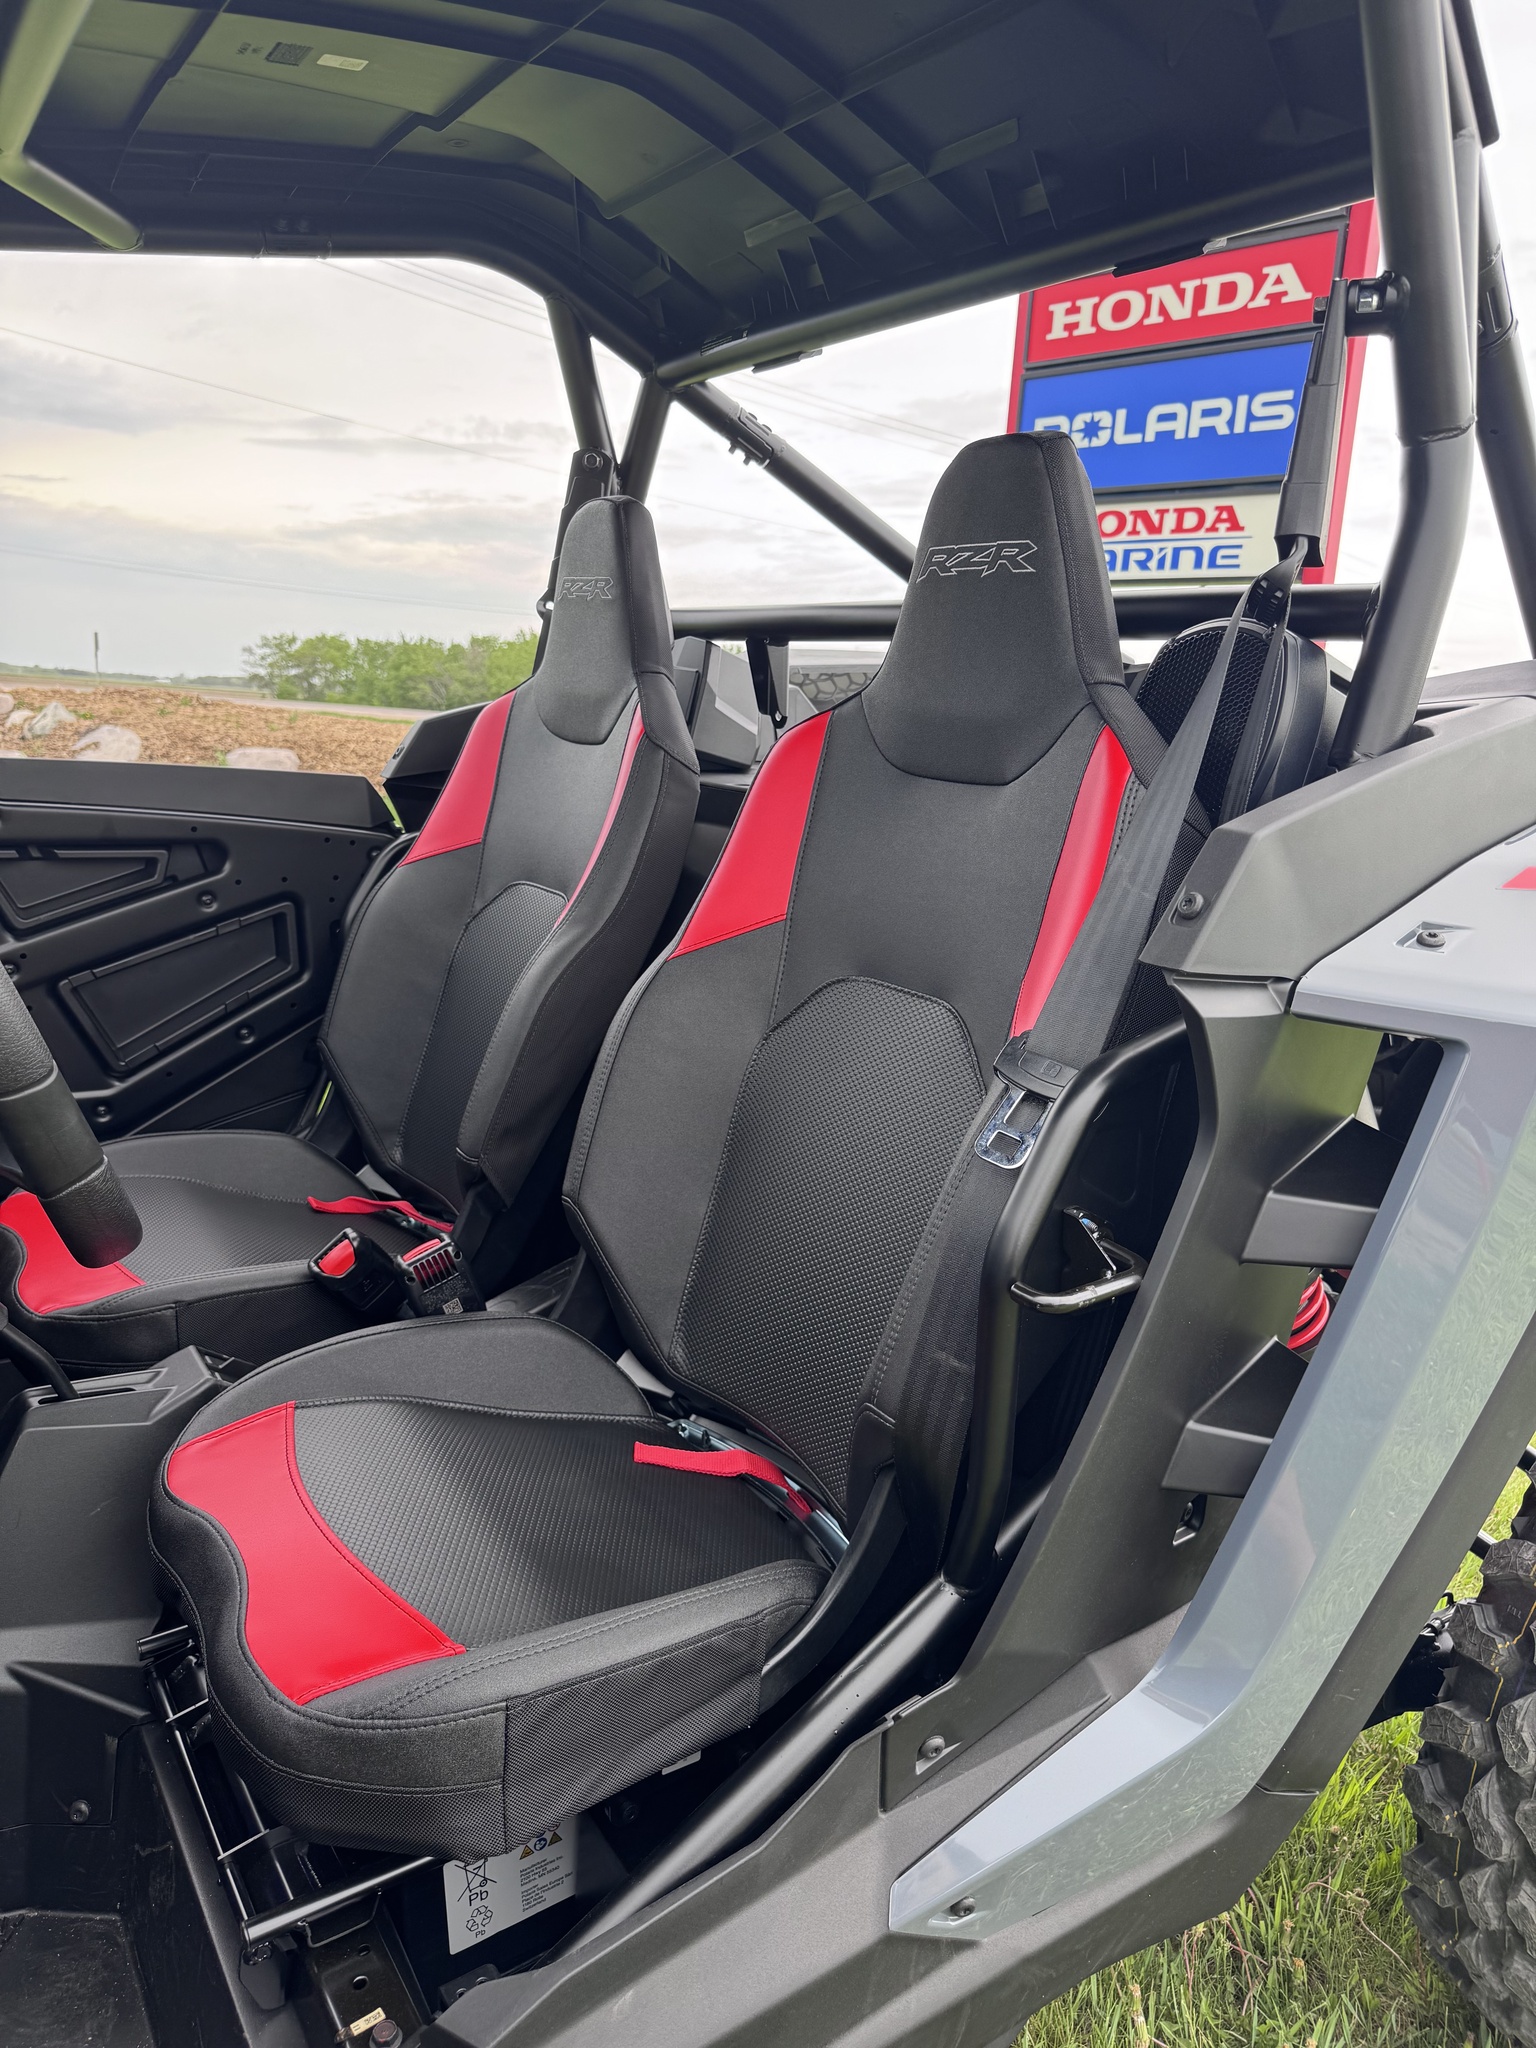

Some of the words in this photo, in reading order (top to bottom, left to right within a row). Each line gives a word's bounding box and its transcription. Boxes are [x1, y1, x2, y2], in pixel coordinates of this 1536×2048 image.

[1046, 262, 1313, 341] HONDA
[1097, 505, 1245, 538] ONDA
[1104, 544, 1243, 572] RINE
[468, 1889, 490, 1907] Pb
[475, 1928, 486, 1938] Pb
